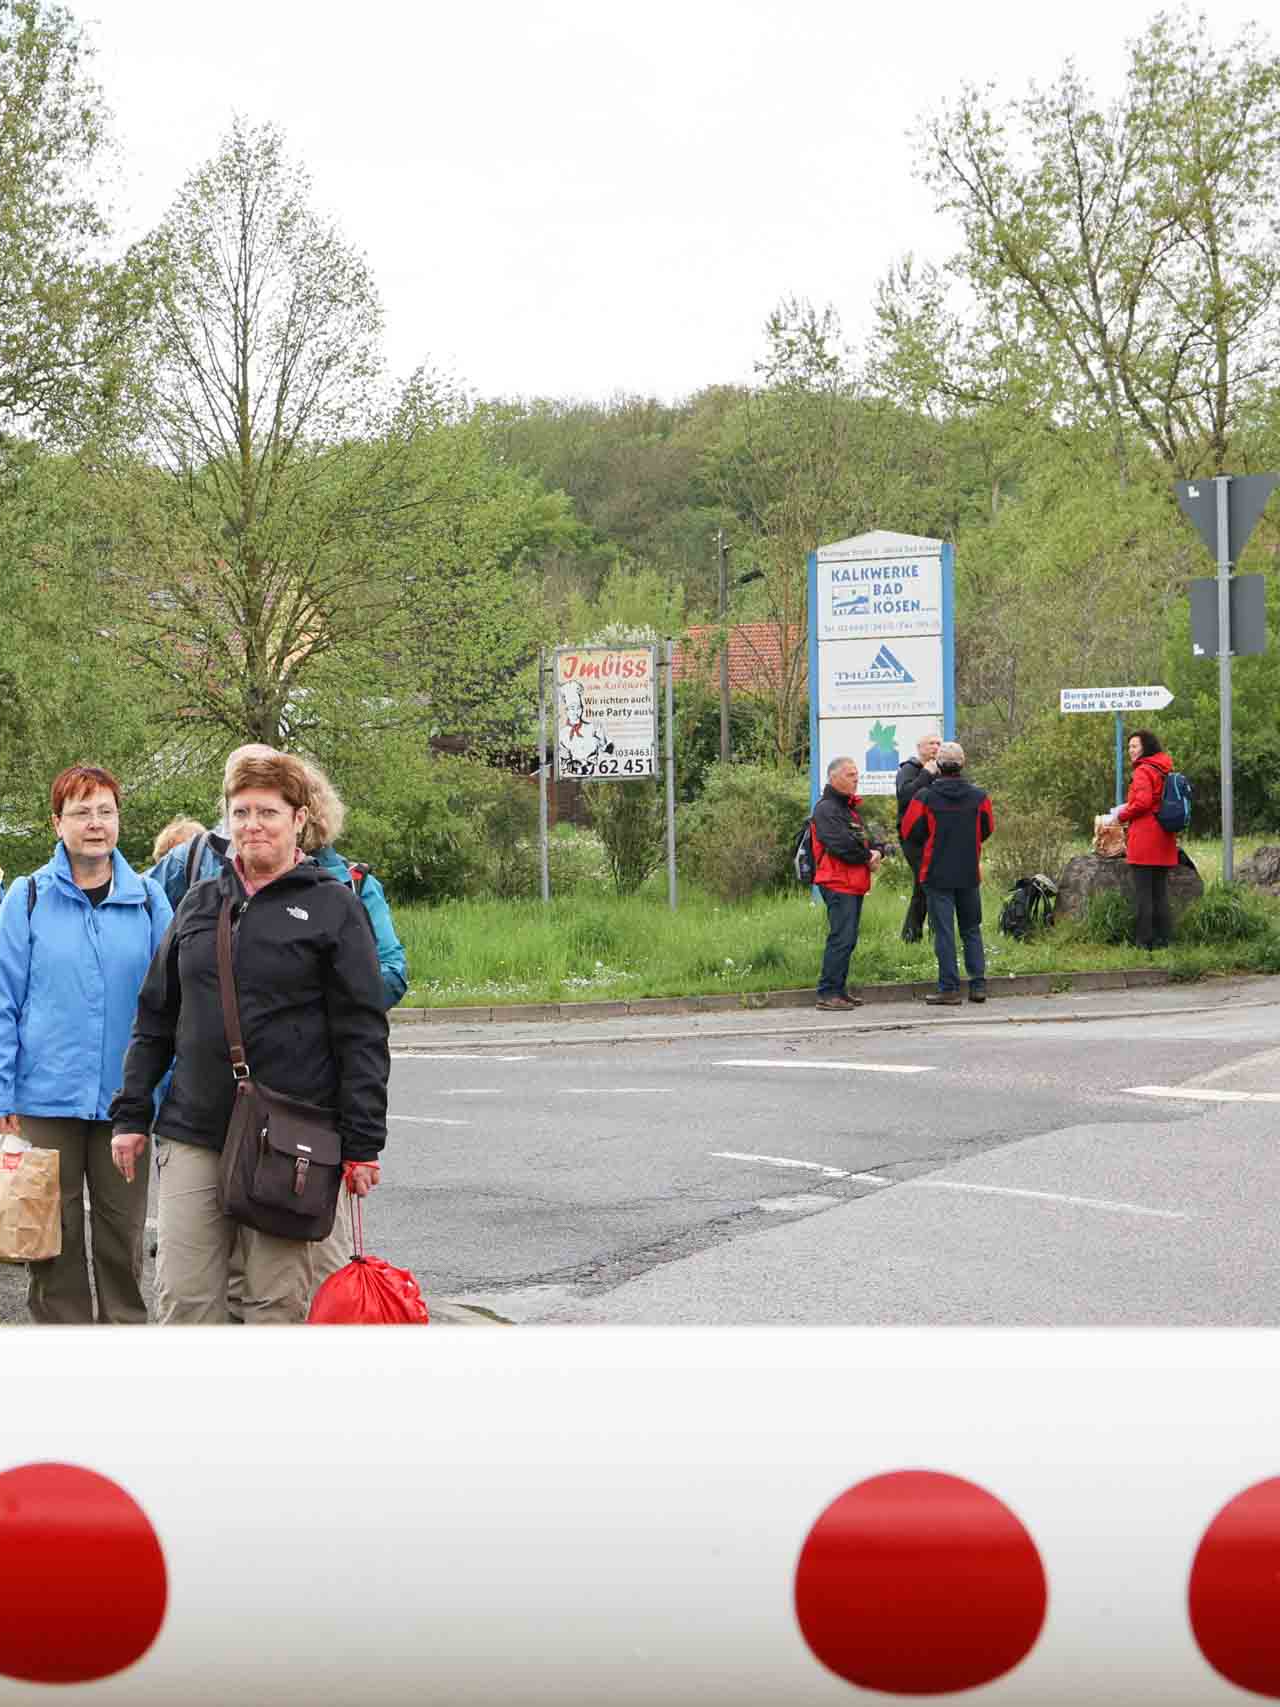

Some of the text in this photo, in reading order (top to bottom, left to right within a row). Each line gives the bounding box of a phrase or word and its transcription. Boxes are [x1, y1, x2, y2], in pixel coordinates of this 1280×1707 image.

[831, 565, 919, 581] KALKWERKE
[873, 583, 903, 596] BAD
[584, 694, 652, 705] Wir richten auch
[585, 707, 605, 718] Ihre
[606, 707, 632, 720] Party
[599, 758, 653, 774] 62 451
